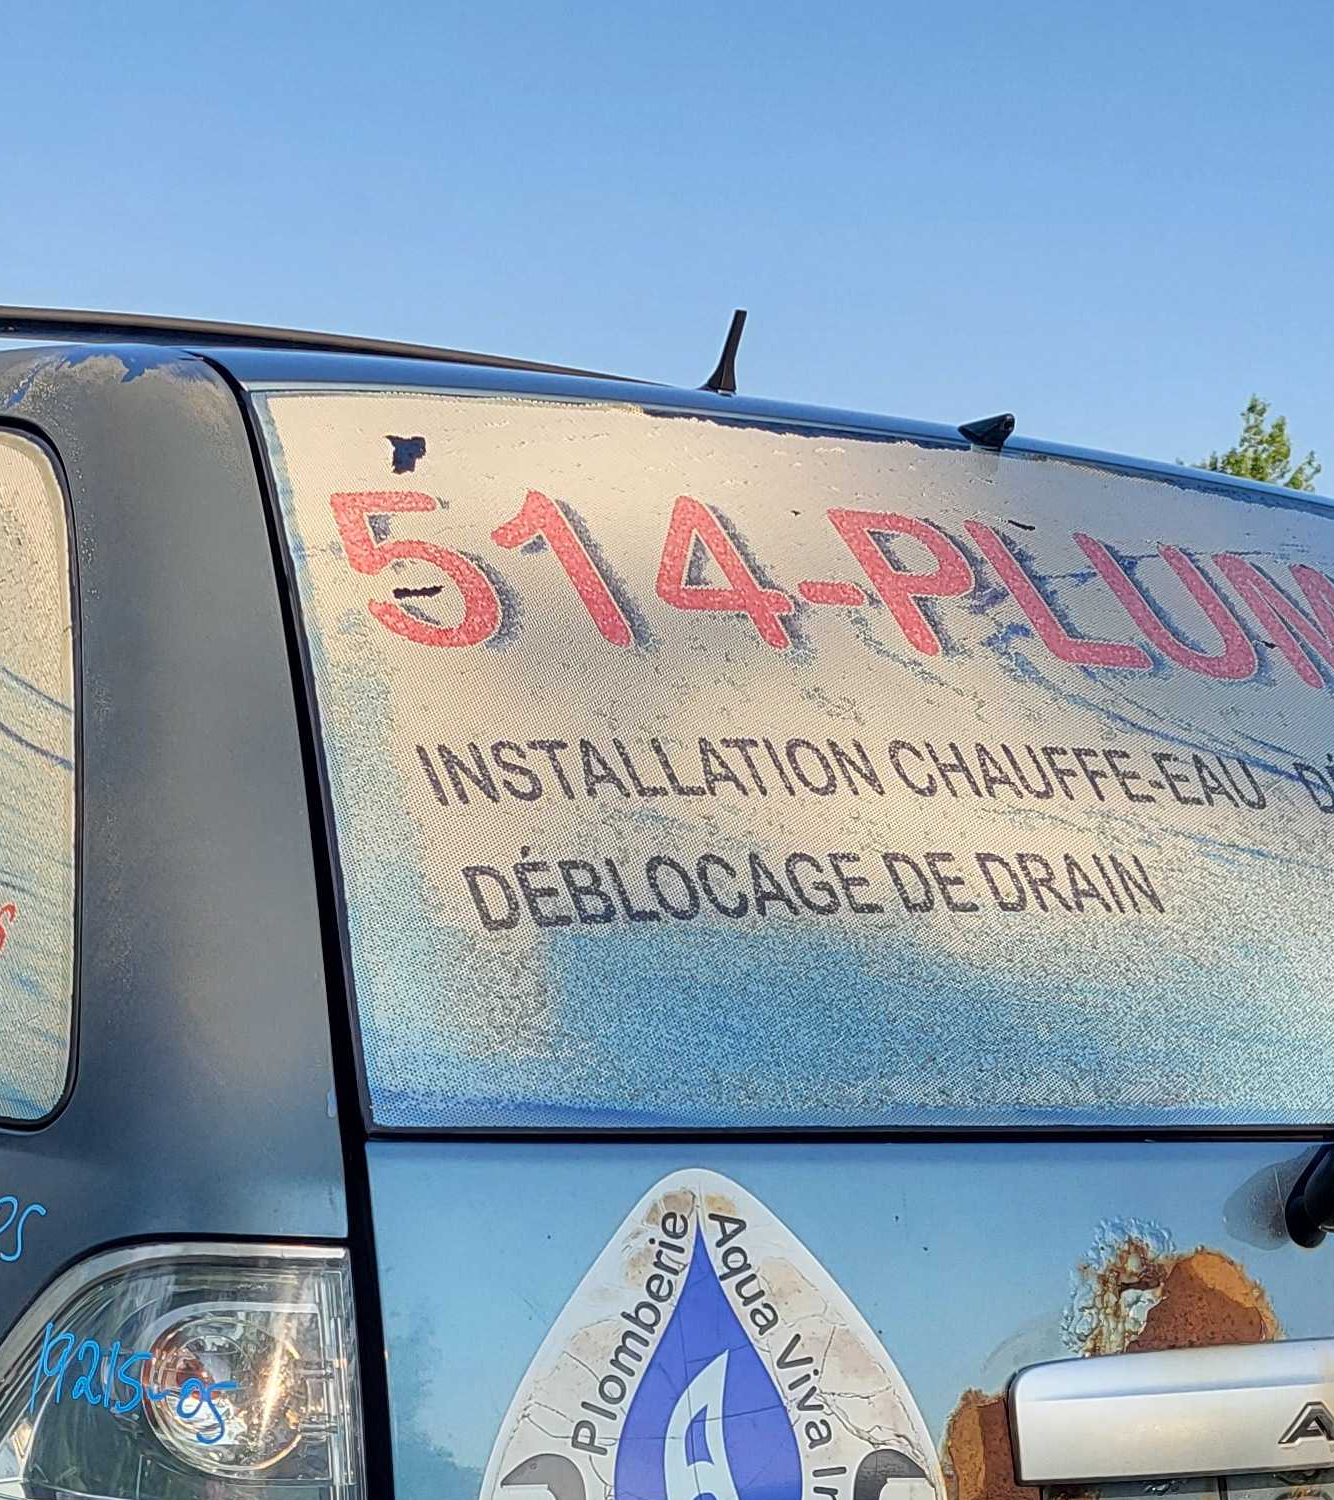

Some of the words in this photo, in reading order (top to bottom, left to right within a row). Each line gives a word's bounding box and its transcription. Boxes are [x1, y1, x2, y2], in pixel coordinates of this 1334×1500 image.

[416, 737, 885, 806] INSTALLATION
[888, 739, 1268, 810] CHAUFFE-EAU
[462, 845, 883, 931] DÉBLOCAGE
[882, 852, 980, 913] DE
[982, 852, 1166, 915] DRAIN
[571, 1209, 690, 1458] Plomberie
[705, 1210, 779, 1338] Aqua
[772, 1332, 833, 1462] Viva
